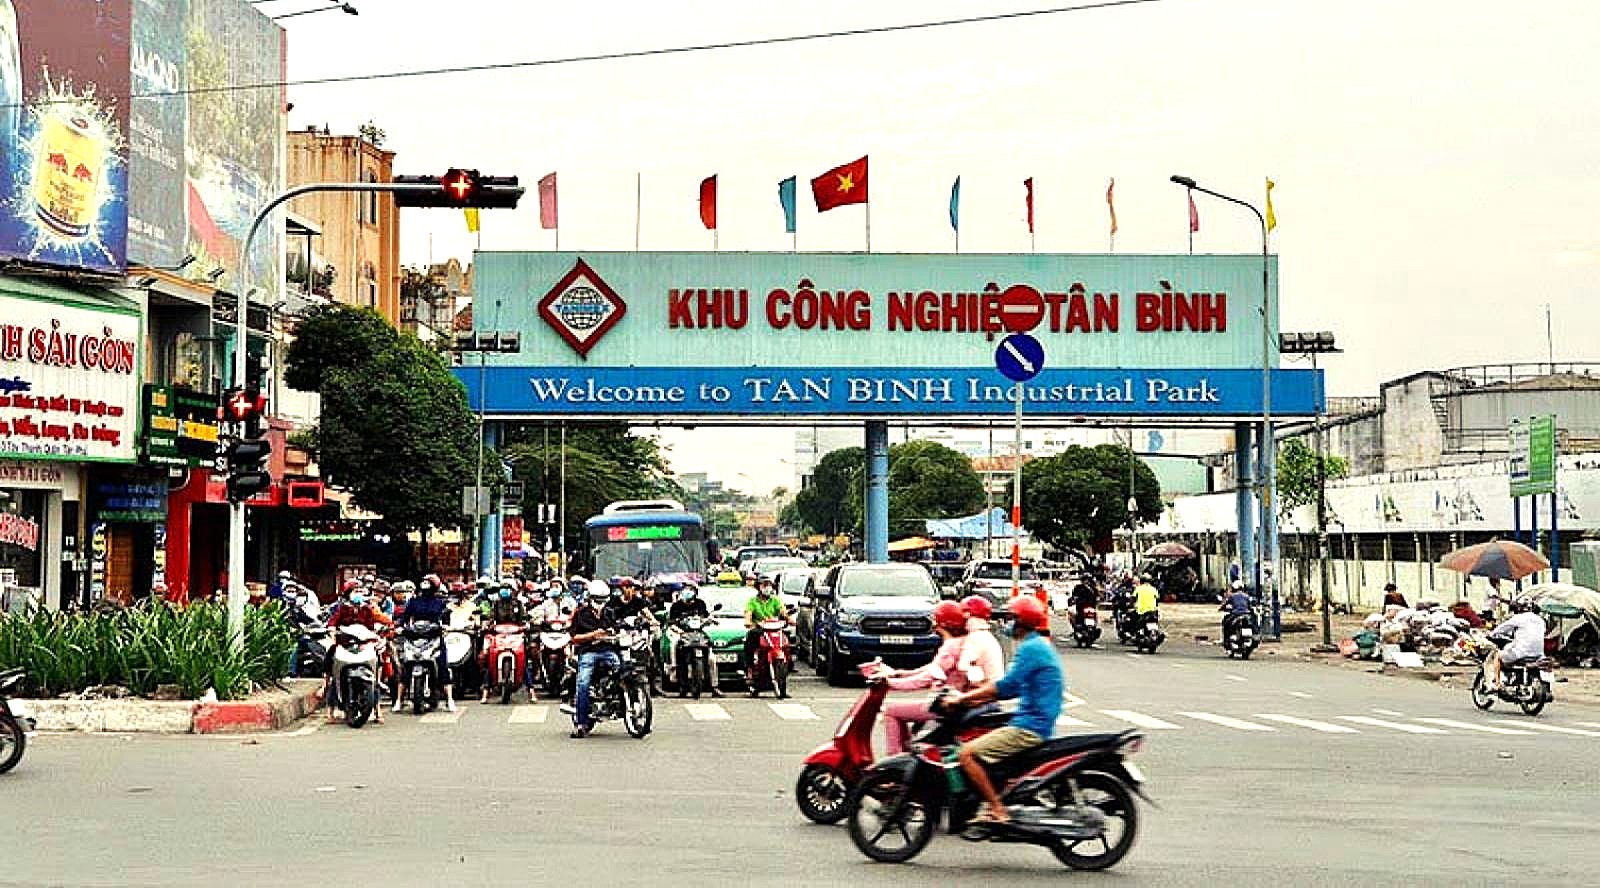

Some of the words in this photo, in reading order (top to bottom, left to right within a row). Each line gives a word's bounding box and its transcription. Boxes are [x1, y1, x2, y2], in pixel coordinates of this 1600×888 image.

[669, 288, 748, 329] KHU
[766, 279, 871, 331] CÔNG
[888, 282, 1004, 342] NGHIỆ
[1043, 282, 1119, 334] TÂN
[1135, 281, 1227, 333] BÌNH
[0, 323, 24, 361] H
[530, 377, 685, 402] Welcome
[700, 384, 731, 402] to
[743, 377, 831, 402] TAN
[847, 377, 953, 402] BINH
[968, 377, 1134, 402] Industrial
[1147, 378, 1219, 402] Park
